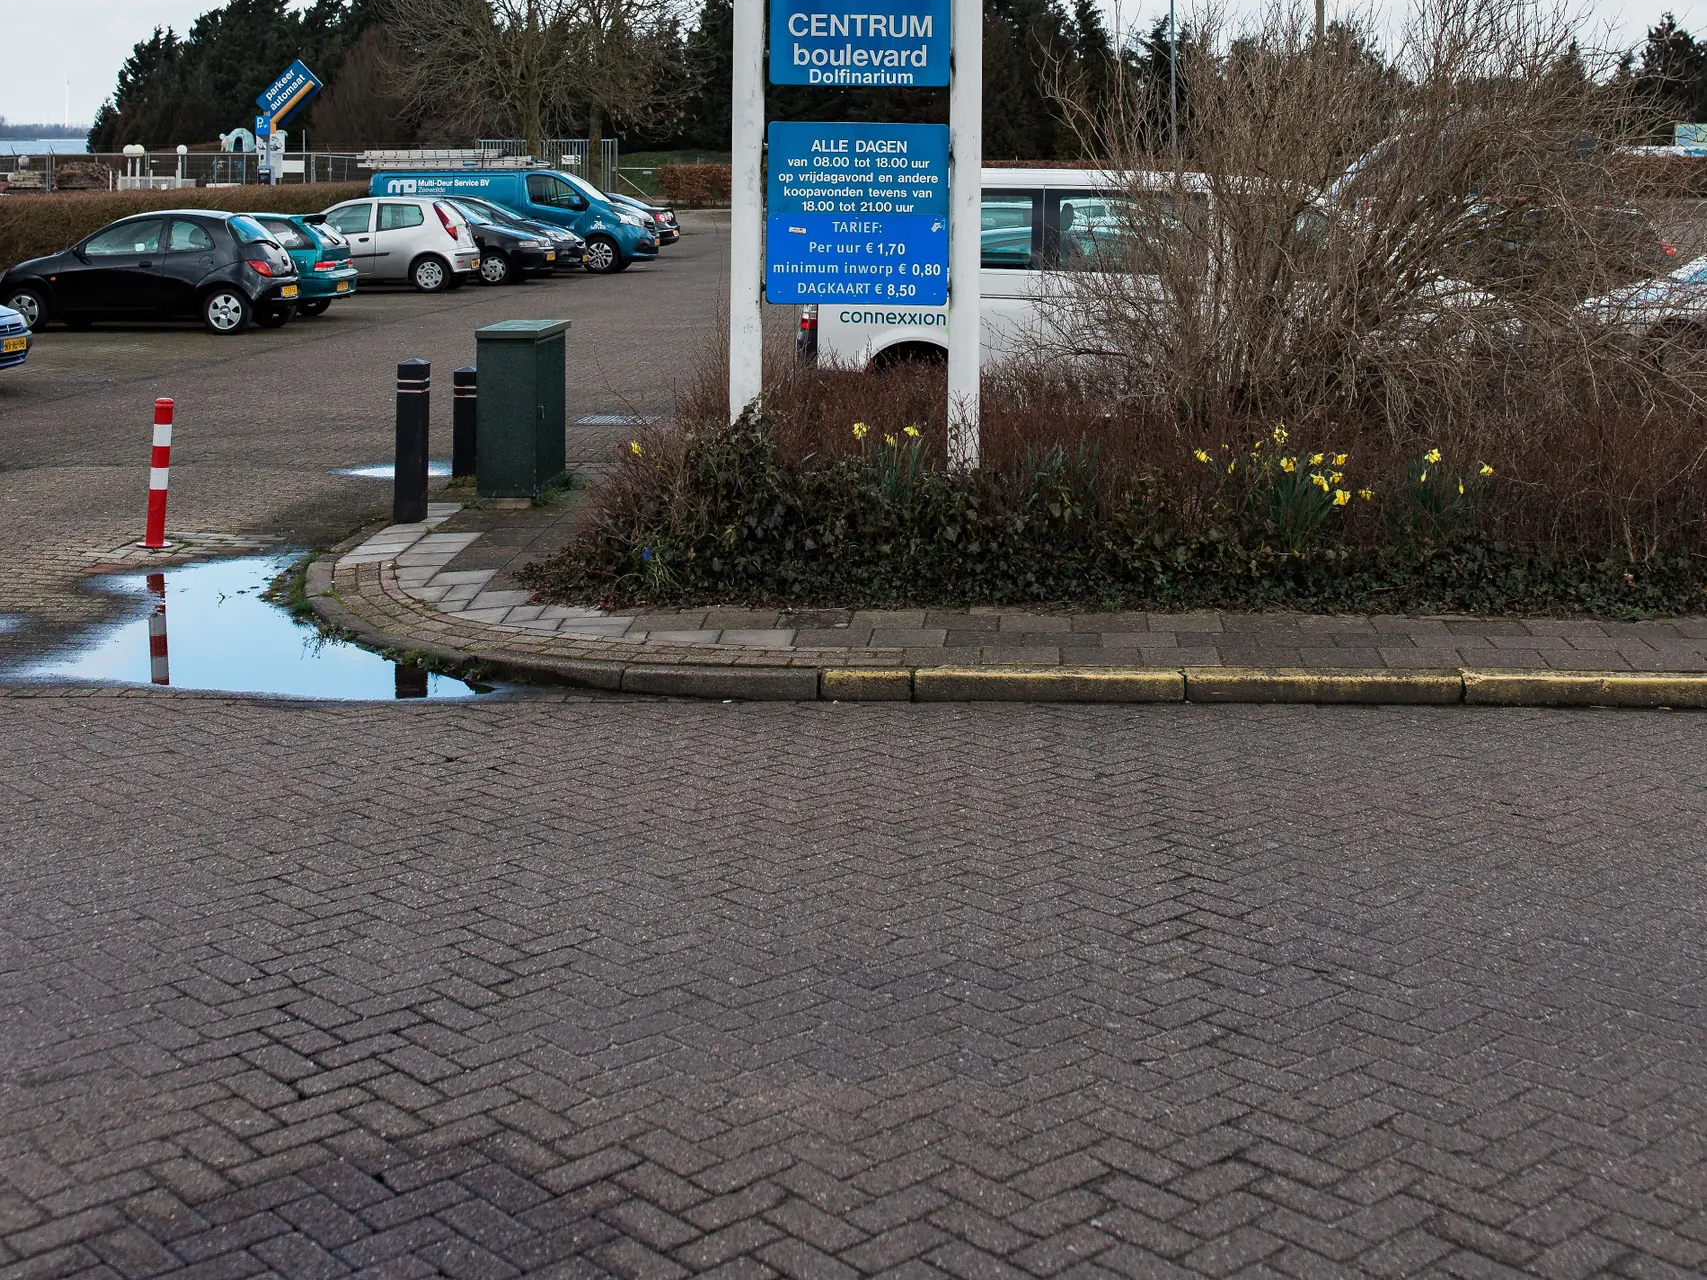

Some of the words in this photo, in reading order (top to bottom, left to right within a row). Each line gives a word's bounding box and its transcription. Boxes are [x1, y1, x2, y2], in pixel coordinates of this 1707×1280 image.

[788, 13, 933, 38] CENTRUM
[793, 43, 927, 67] boulevard
[809, 69, 914, 85] Dolfinarium
[265, 69, 295, 101] parkeer
[270, 73, 306, 111] automaat
[811, 139, 849, 153] ALLE
[855, 140, 908, 154] DAGEN
[787, 158, 808, 167] van
[813, 157, 850, 167] 08.00
[854, 158, 870, 168] tot
[875, 157, 908, 168] 18.00
[911, 160, 930, 169] uur
[418, 179, 453, 187] Multi-Deur
[453, 179, 479, 187] Service
[480, 179, 490, 187] BV
[778, 173, 794, 183] op
[798, 171, 874, 184] vrijdagavond
[878, 174, 893, 183] en
[897, 173, 939, 183] andere
[783, 186, 863, 198] koopavonden
[868, 188, 907, 198] tevens
[912, 189, 933, 198] van
[801, 201, 835, 212] 18.00
[839, 202, 856, 212] tot
[860, 201, 892, 212] 21.00
[895, 204, 914, 213] uur
[832, 221, 883, 234] TARIEF:
[809, 242, 832, 253] Per
[836, 244, 861, 254] uur
[865, 242, 874, 254] €
[877, 243, 906, 256] 1,70
[773, 262, 839, 274] minimum
[844, 262, 893, 277] inworp
[898, 263, 906, 275] €
[912, 263, 941, 278] 0,80
[797, 282, 871, 294] DAGKAART
[874, 283, 883, 294] €
[887, 284, 916, 297] 8,50
[839, 311, 947, 326] connexxion
